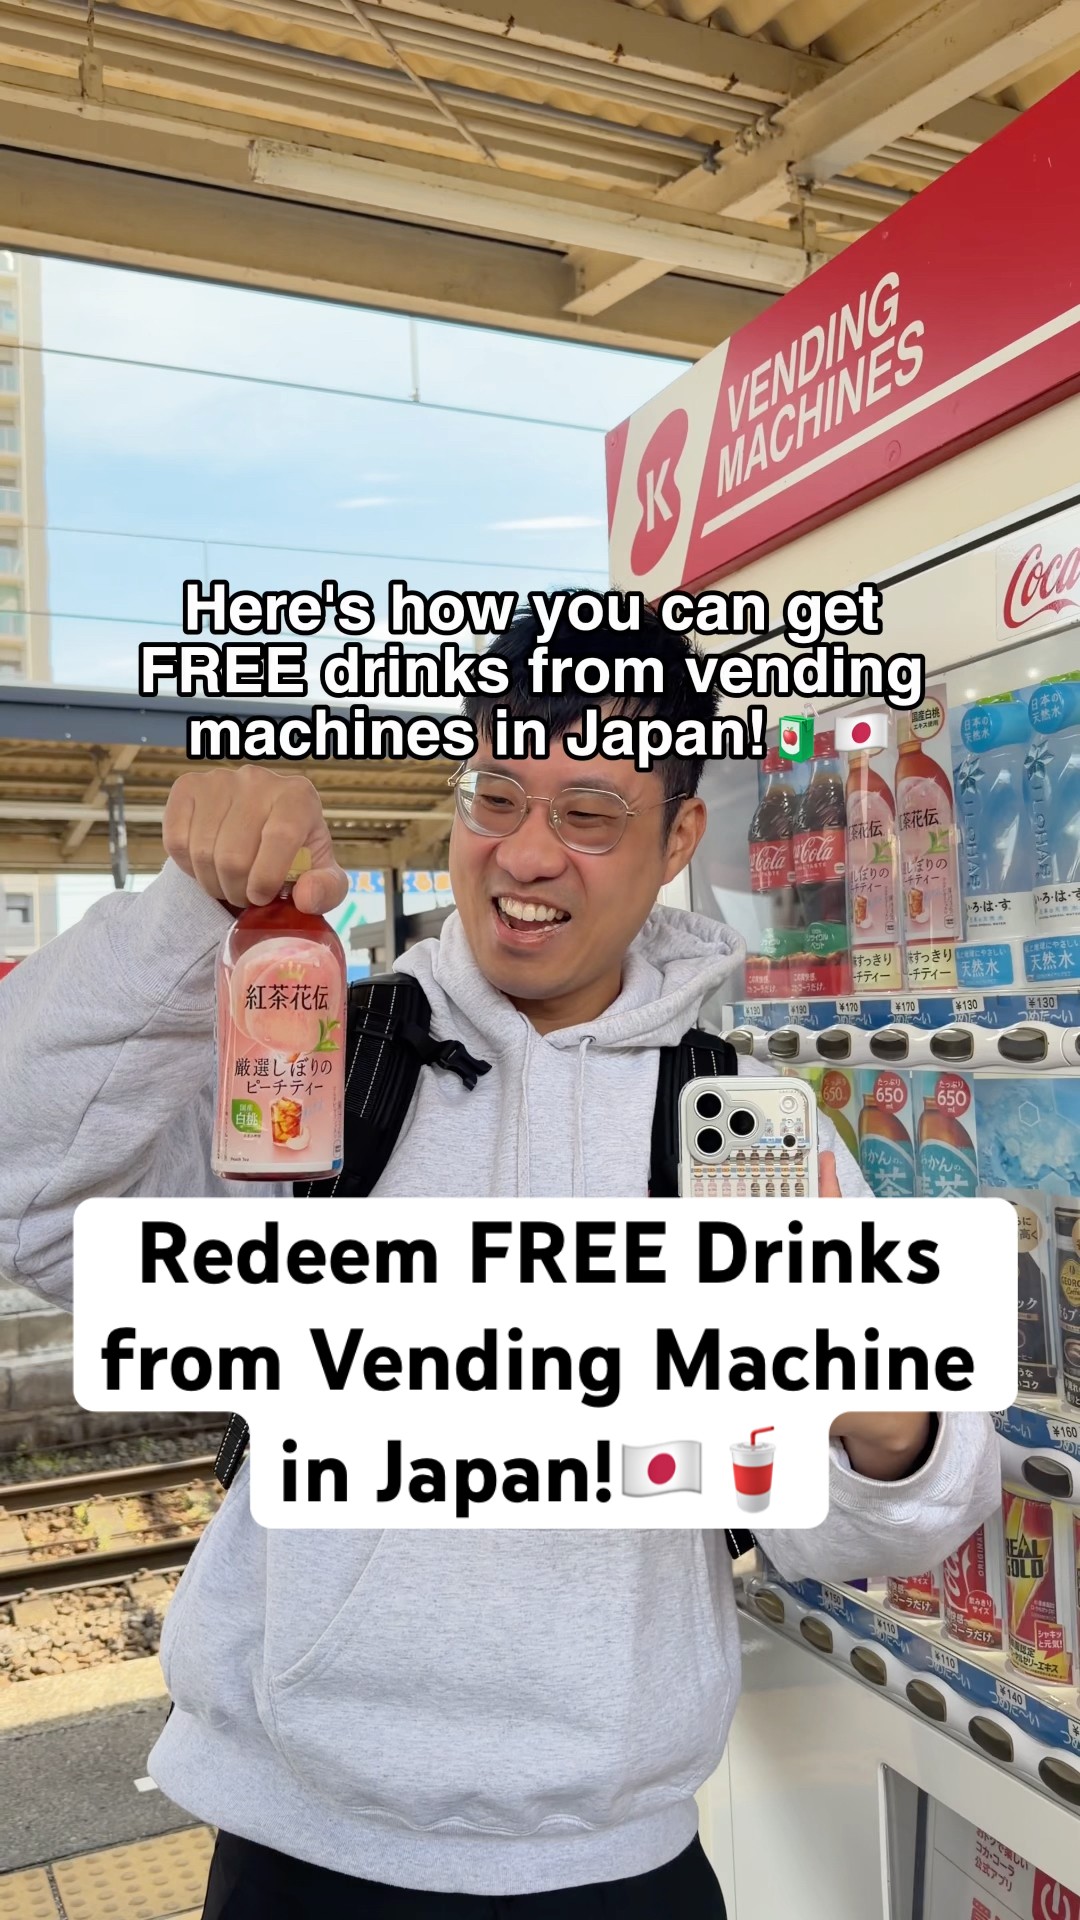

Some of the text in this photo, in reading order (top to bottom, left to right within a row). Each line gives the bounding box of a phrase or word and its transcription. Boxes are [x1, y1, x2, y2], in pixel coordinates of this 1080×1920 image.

[727, 271, 901, 433] VENDING
[716, 320, 925, 498] MACHINES
[645, 458, 674, 532] K
[911, 706, 941, 723] 国産白桃
[904, 856, 948, 874] しぼりの
[851, 866, 890, 883] しぼりの
[961, 958, 1000, 977] 天然水
[1030, 949, 1076, 972] 天然水
[244, 984, 330, 1011] 紅茶花伝
[955, 1000, 978, 1011] ¥130
[1028, 997, 1055, 1009] ¥130
[839, 1002, 859, 1012] ¥170
[895, 1001, 916, 1012] ¥170
[234, 1057, 333, 1078] 厳選しぼりの
[246, 1080, 324, 1096] ピーチティー
[877, 1079, 901, 1087] たっぷり
[939, 1080, 964, 1089] たっぷり
[823, 1086, 844, 1102] 650
[876, 1087, 904, 1103] 650
[937, 1090, 967, 1107] 650
[236, 1112, 259, 1127] 白桃
[1053, 1425, 1078, 1438] ¥160
[877, 1619, 896, 1635] ¥110
[1037, 1629, 1063, 1639] シャキッ
[934, 1650, 956, 1669] ¥110
[1000, 1685, 1024, 1706] ¥140
[974, 1855, 1013, 1892] 公式アプリ
